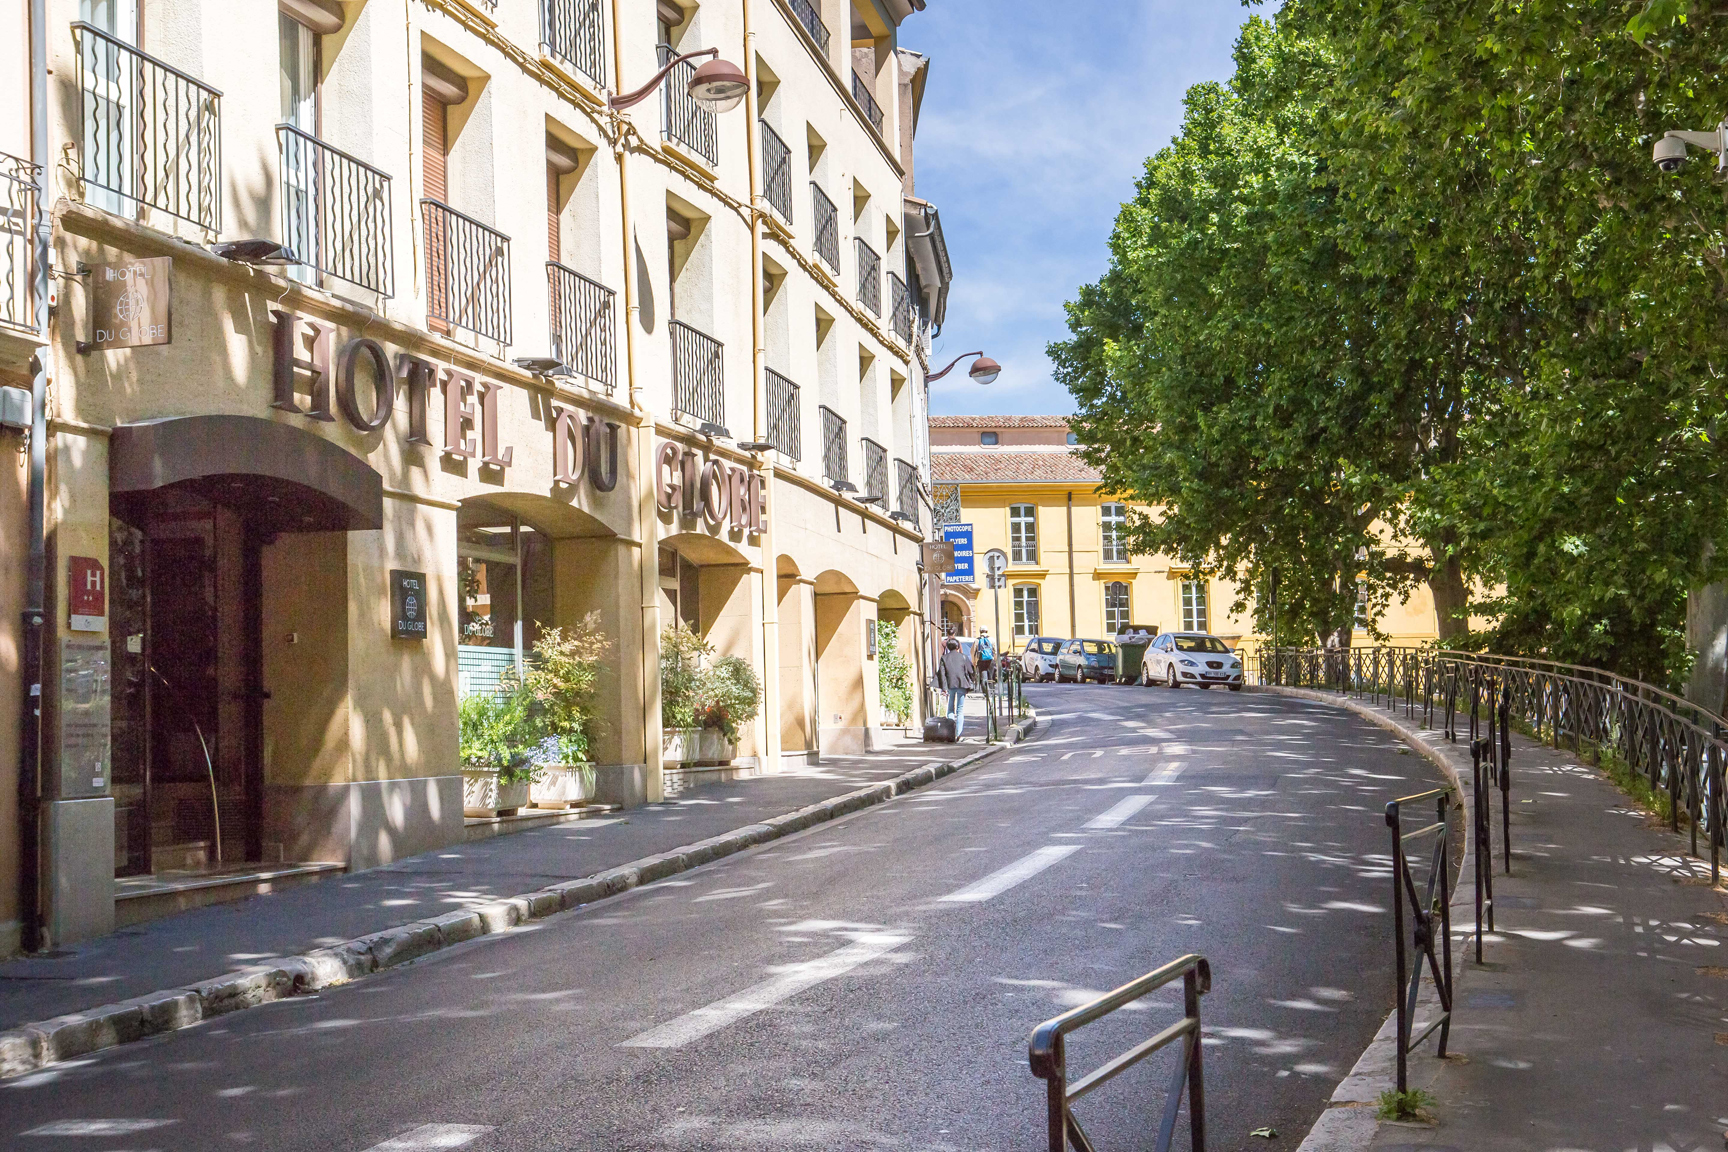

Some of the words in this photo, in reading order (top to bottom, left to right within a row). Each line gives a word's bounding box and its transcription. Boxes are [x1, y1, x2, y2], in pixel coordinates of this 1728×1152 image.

[105, 266, 151, 282] HOTEL
[96, 329, 115, 342] DU
[119, 325, 165, 340] GOBE
[269, 309, 513, 468] HOTEL
[552, 405, 621, 492] DU
[656, 441, 768, 534] GLOBE
[86, 569, 101, 591] H
[402, 579, 419, 589] HOTEL
[398, 620, 407, 630] DU
[407, 621, 425, 631] GLOBE
